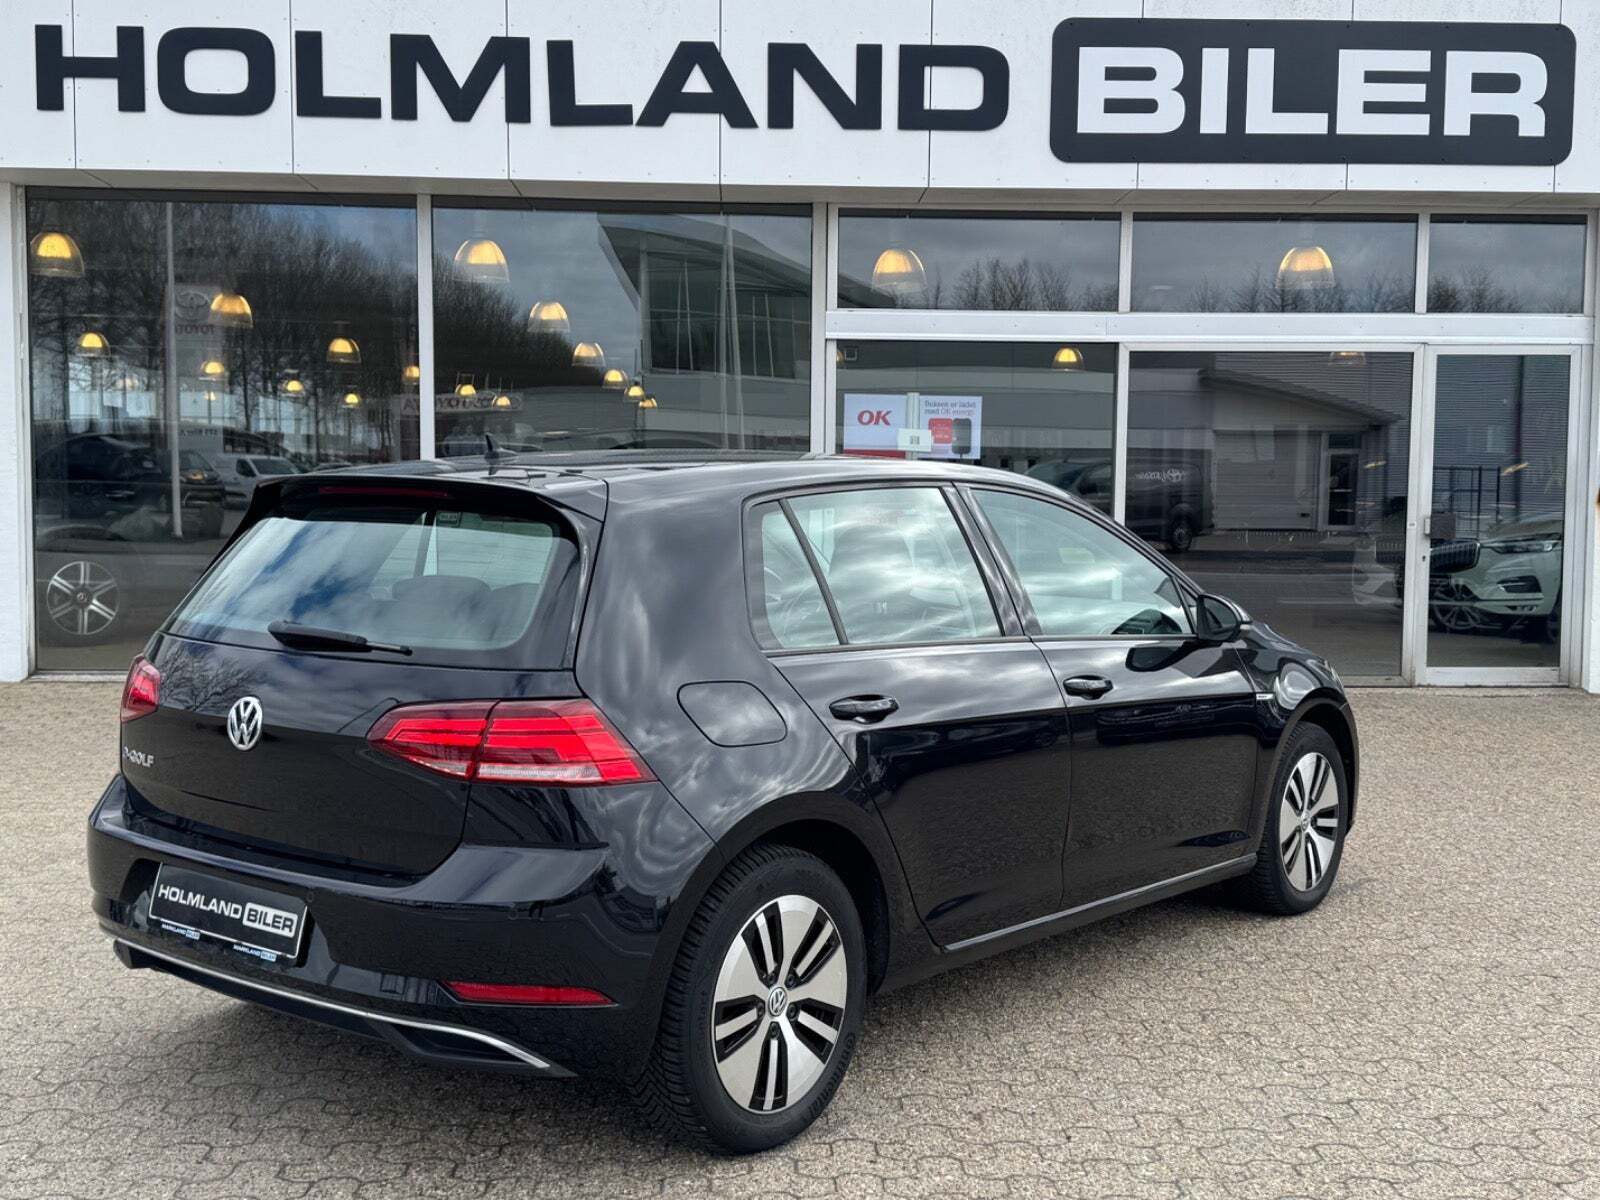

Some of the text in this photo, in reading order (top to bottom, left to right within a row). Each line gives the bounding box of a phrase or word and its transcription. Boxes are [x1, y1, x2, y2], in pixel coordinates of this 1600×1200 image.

[35, 25, 1547, 136] HOLMLAND BILER
[857, 410, 892, 426] OK
[158, 884, 294, 933] HOLMLAND BILER
